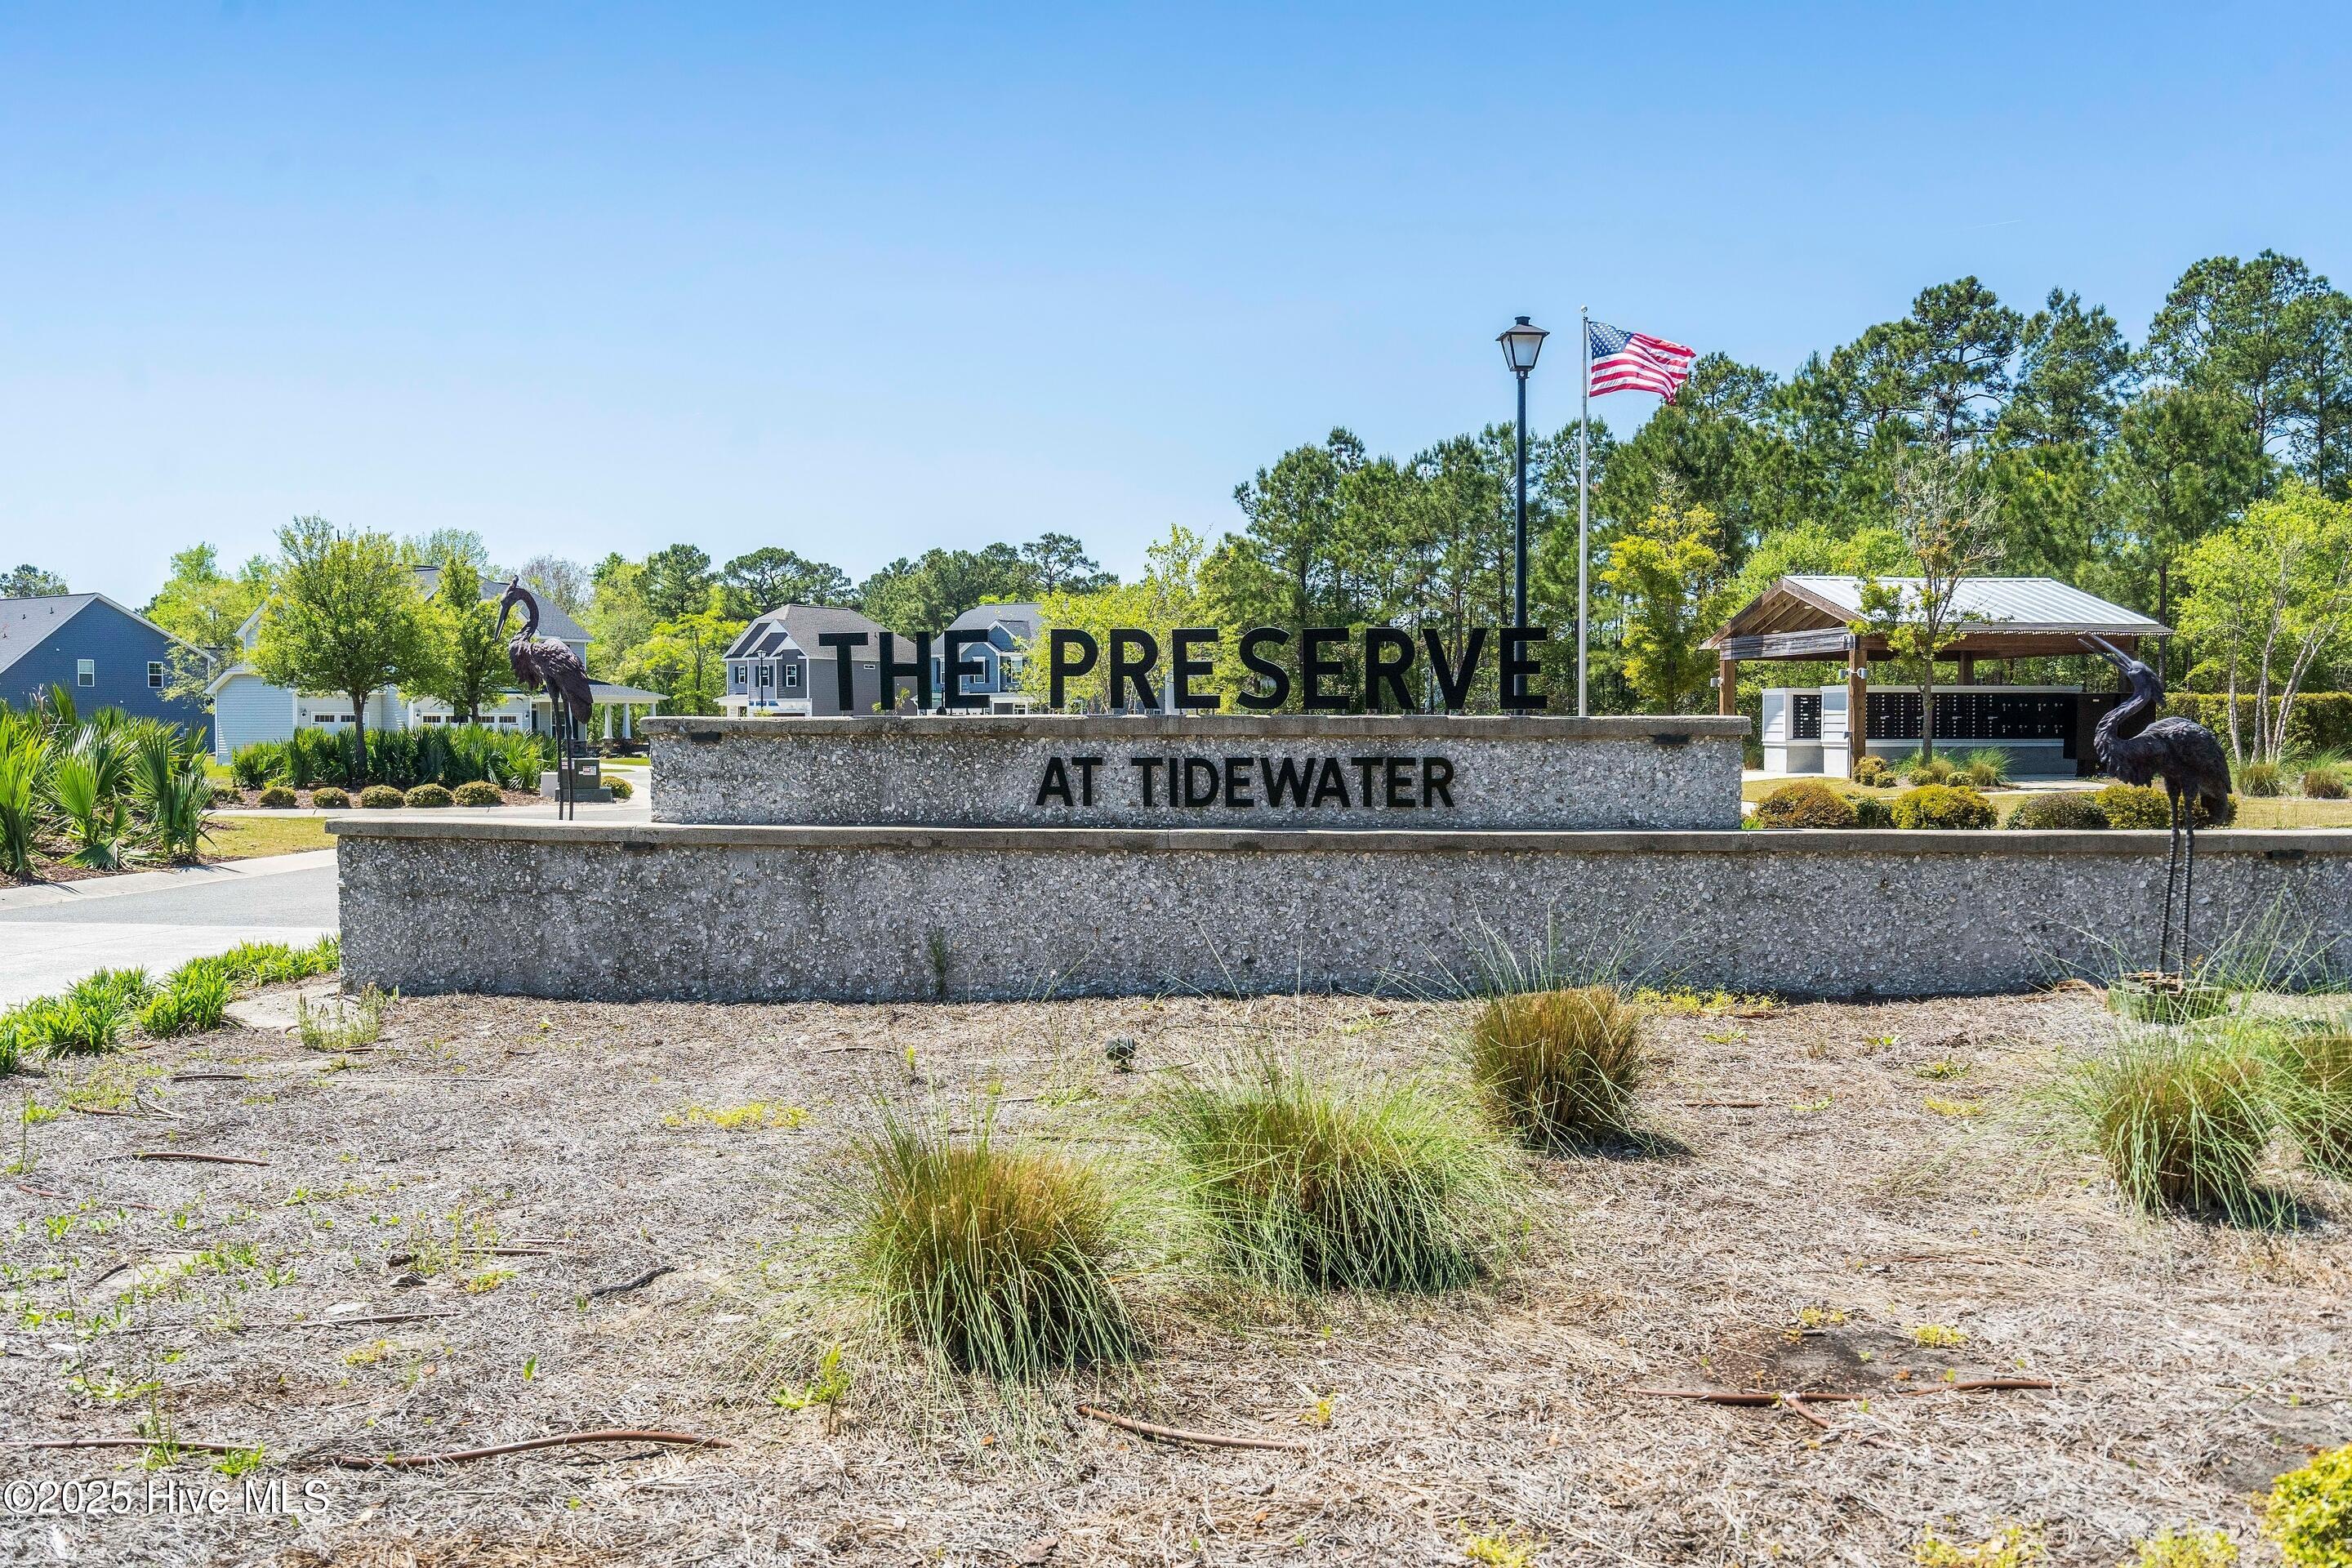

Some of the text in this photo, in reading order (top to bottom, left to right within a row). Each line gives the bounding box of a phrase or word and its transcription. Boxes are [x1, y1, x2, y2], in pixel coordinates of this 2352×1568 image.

[818, 627, 1548, 710] THE PRESERVE
[1036, 756, 1454, 808] AT TIDEWATER
